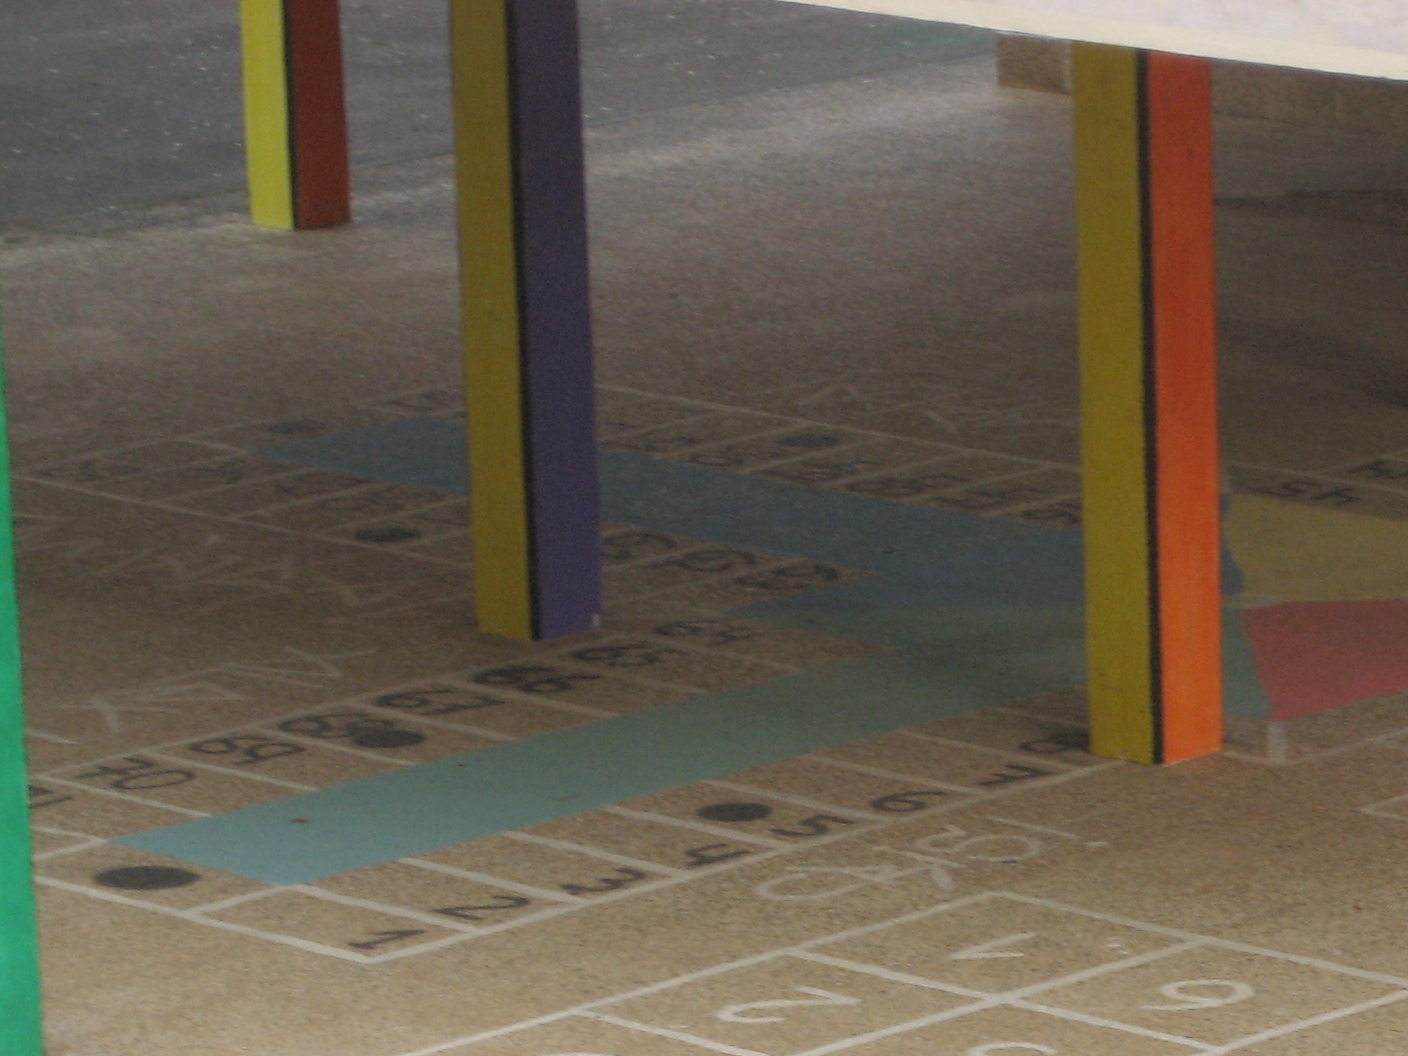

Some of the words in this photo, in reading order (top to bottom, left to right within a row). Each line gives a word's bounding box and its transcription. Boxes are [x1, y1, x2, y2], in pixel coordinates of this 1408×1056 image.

[571, 642, 684, 668] 65
[471, 662, 605, 693] 66
[373, 687, 507, 717] 67
[187, 734, 306, 767] 69
[74, 757, 196, 790] 70
[870, 790, 946, 815] 6
[767, 813, 856, 839] 5
[685, 841, 754, 869] 4
[559, 867, 647, 896] 3
[432, 895, 532, 922] 2
[349, 928, 428, 952] 1
[716, 986, 862, 1025] 2
